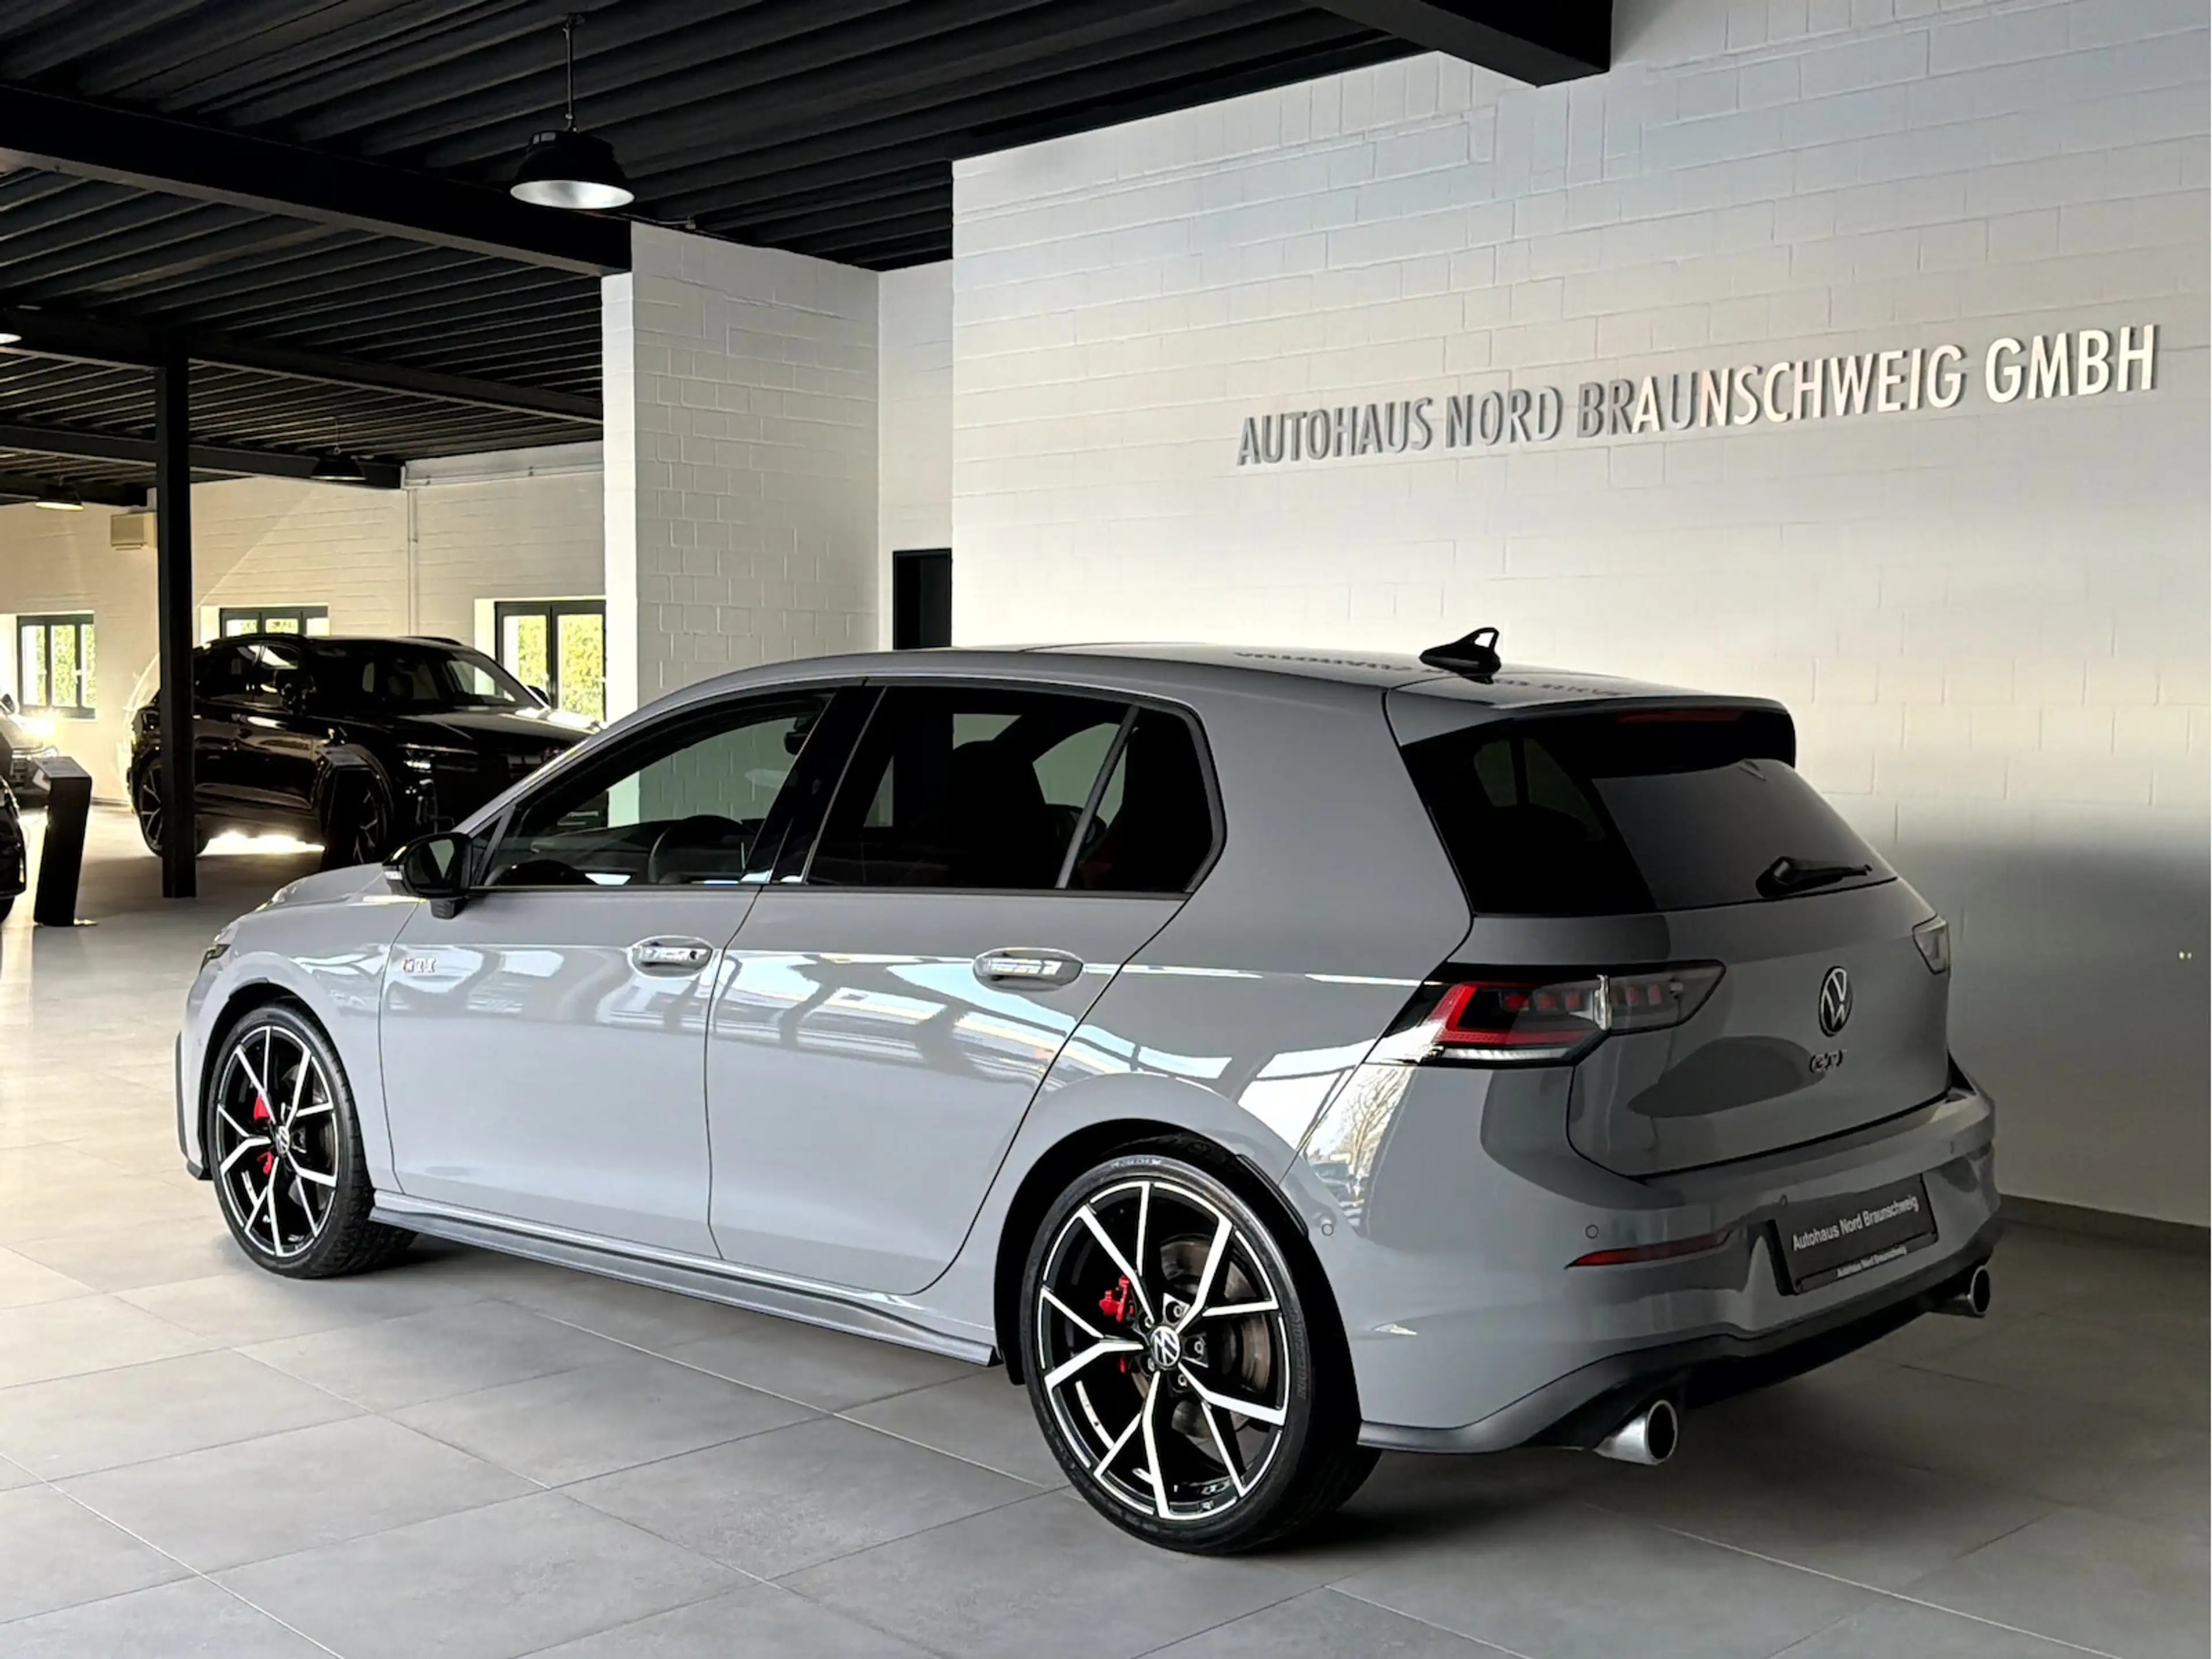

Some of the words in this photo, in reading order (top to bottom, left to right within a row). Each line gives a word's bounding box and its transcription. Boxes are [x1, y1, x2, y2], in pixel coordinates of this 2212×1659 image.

[1236, 397, 1434, 465] AUTOHAUS
[1445, 385, 1565, 448] NORD
[1577, 344, 1967, 438] BRAUNSCHWEIG
[1985, 323, 2161, 404] GMBH
[1793, 1225, 1839, 1251] Autohaus
[1839, 1214, 1863, 1235] Nord
[1862, 1195, 1919, 1226] Braunschweig
